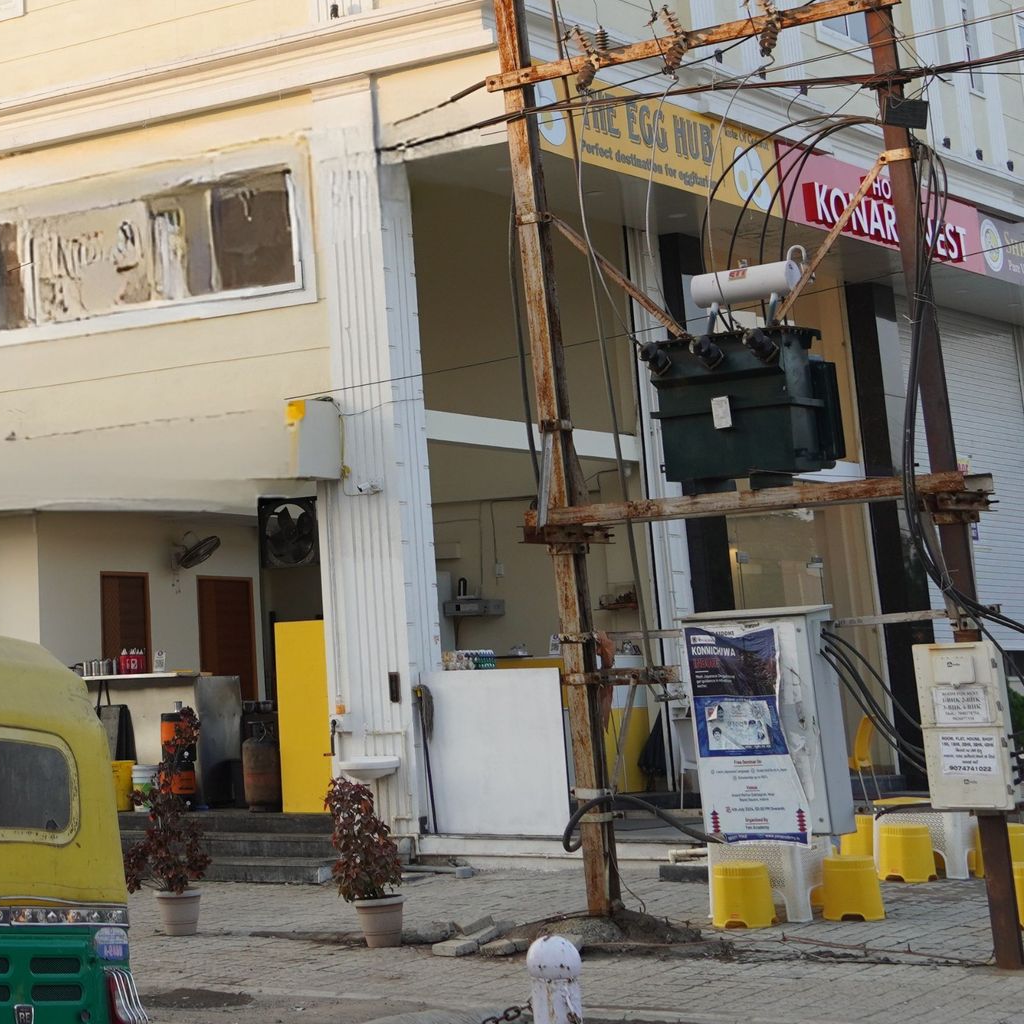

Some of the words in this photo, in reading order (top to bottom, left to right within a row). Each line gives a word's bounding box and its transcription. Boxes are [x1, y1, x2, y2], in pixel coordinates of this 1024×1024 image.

[626, 98, 668, 153] EGG
[672, 114, 714, 166] HUB
[580, 139, 613, 161] Perfect
[615, 149, 663, 175] destination
[664, 162, 676, 177] for
[813, 181, 900, 243] KONAR
[691, 646, 736, 657] KONNICHIWA
[19, 1012, 31, 1024] RE
